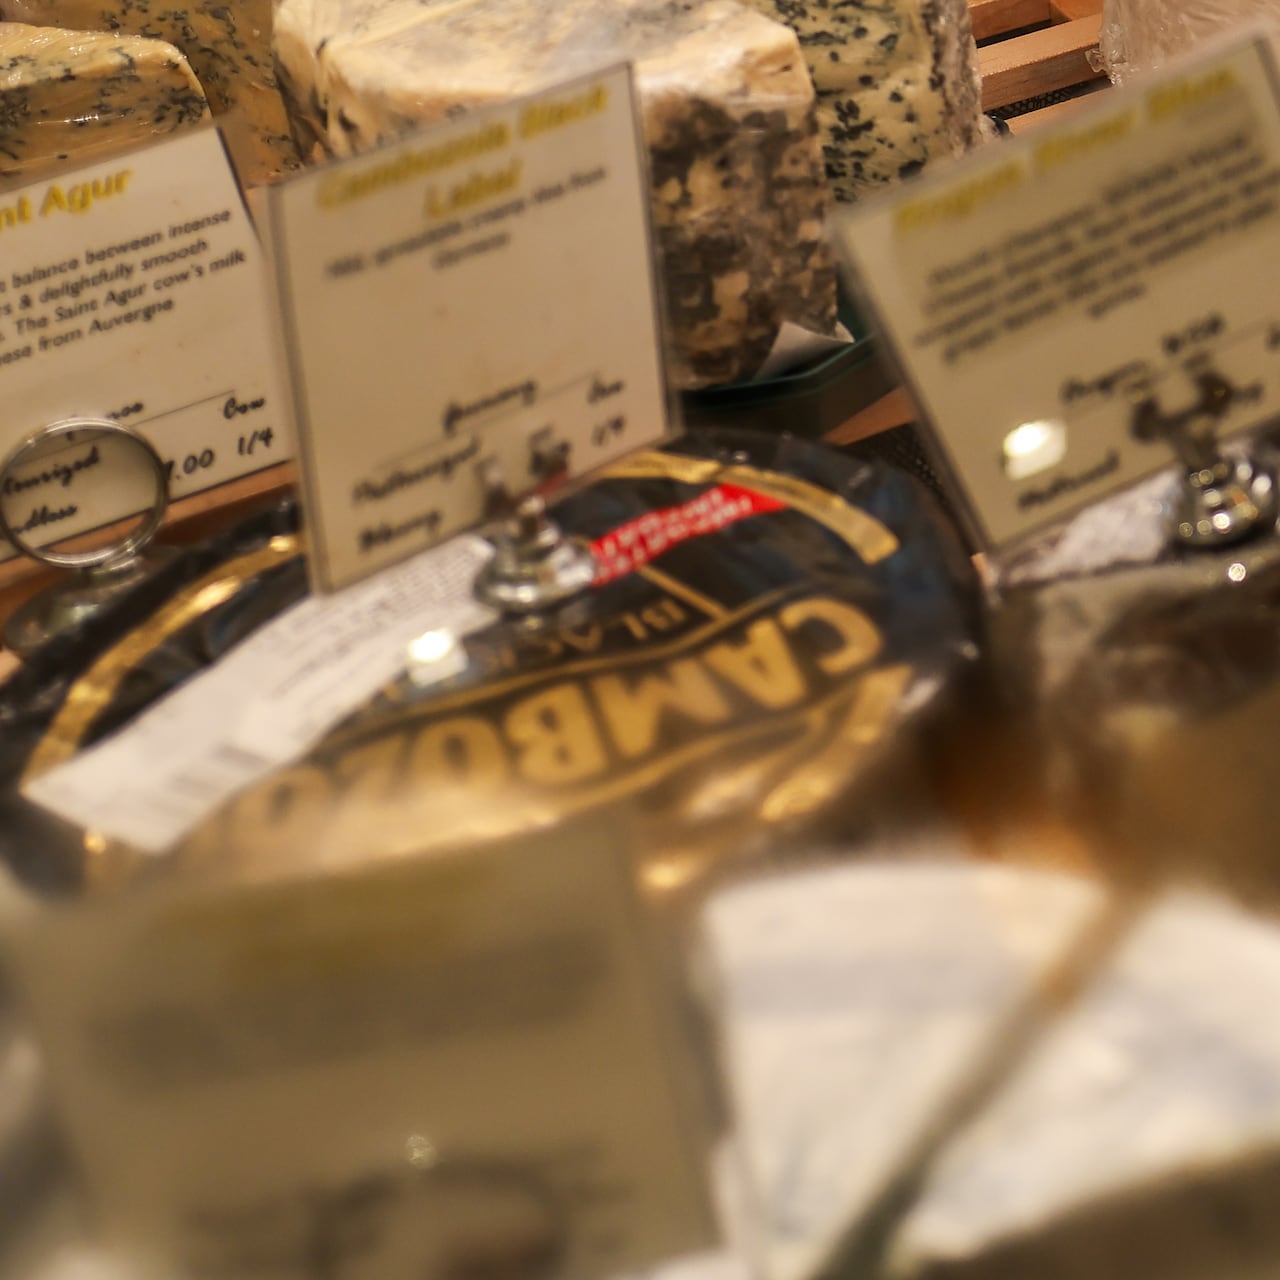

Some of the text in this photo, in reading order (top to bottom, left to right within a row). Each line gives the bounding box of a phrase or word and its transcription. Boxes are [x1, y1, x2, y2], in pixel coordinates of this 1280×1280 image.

[43, 170, 133, 216] Agur
[12, 210, 231, 288] balance between intense
[16, 316, 48, 330] The
[55, 300, 97, 321] Saint
[106, 286, 143, 306] Agur
[209, 249, 245, 271] milk
[21, 294, 31, 309] &
[141, 239, 208, 270] smooth
[38, 329, 83, 350] from
[223, 397, 265, 419] Cow
[237, 427, 273, 455] 1/4
